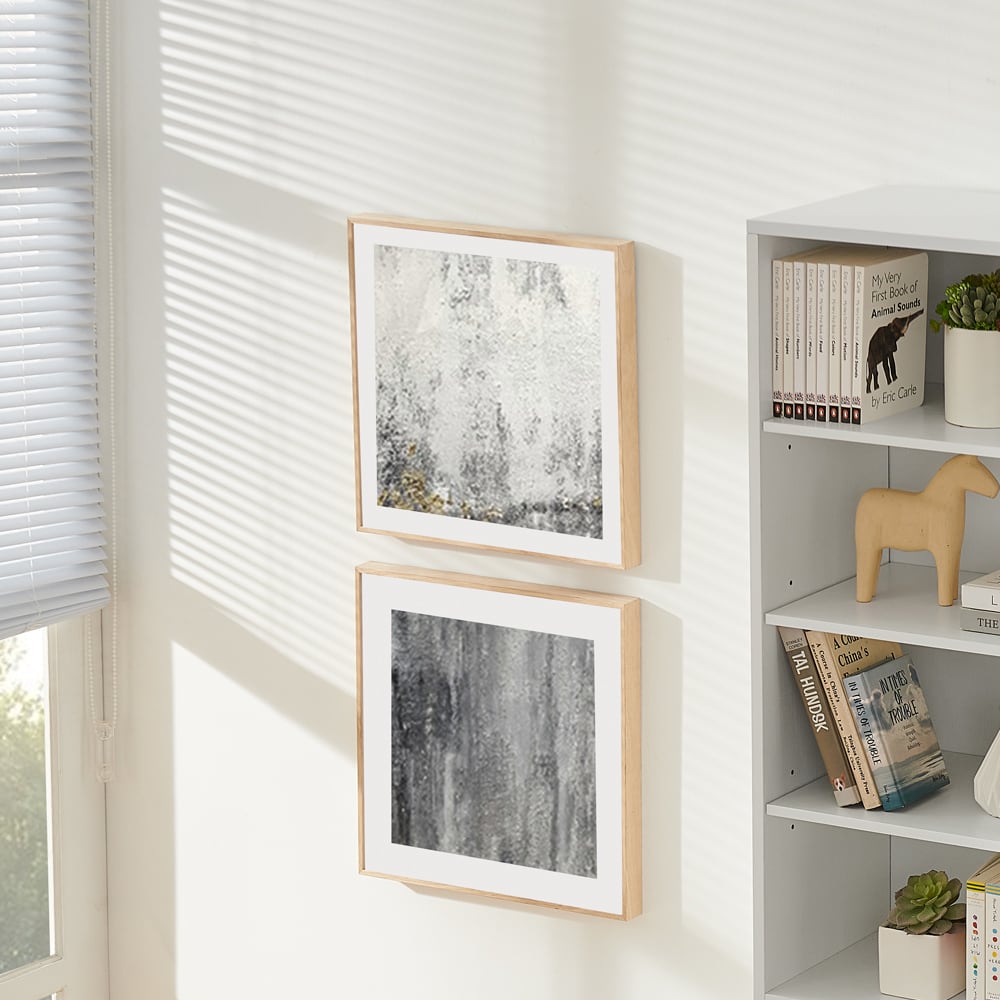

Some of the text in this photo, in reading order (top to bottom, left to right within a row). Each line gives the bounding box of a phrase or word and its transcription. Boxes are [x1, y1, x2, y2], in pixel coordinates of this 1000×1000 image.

[872, 272, 901, 288] My Very
[872, 280, 918, 303] First Book of
[872, 298, 920, 318] Animal Sounds
[872, 396, 880, 409] by
[883, 391, 895, 404] Eric
[898, 384, 917, 398] Carle
[977, 618, 999, 629] THE
[834, 637, 840, 650] A
[838, 646, 869, 667] China's
[792, 651, 828, 732] TAL HUNDSK
[848, 681, 858, 691] IN
[880, 670, 908, 694] IN TIMES
[852, 694, 866, 716] TIMES
[893, 688, 903, 705] OF
[860, 717, 870, 727] OF
[888, 700, 918, 726] TROUBLE
[864, 730, 882, 765] TROUBLE
